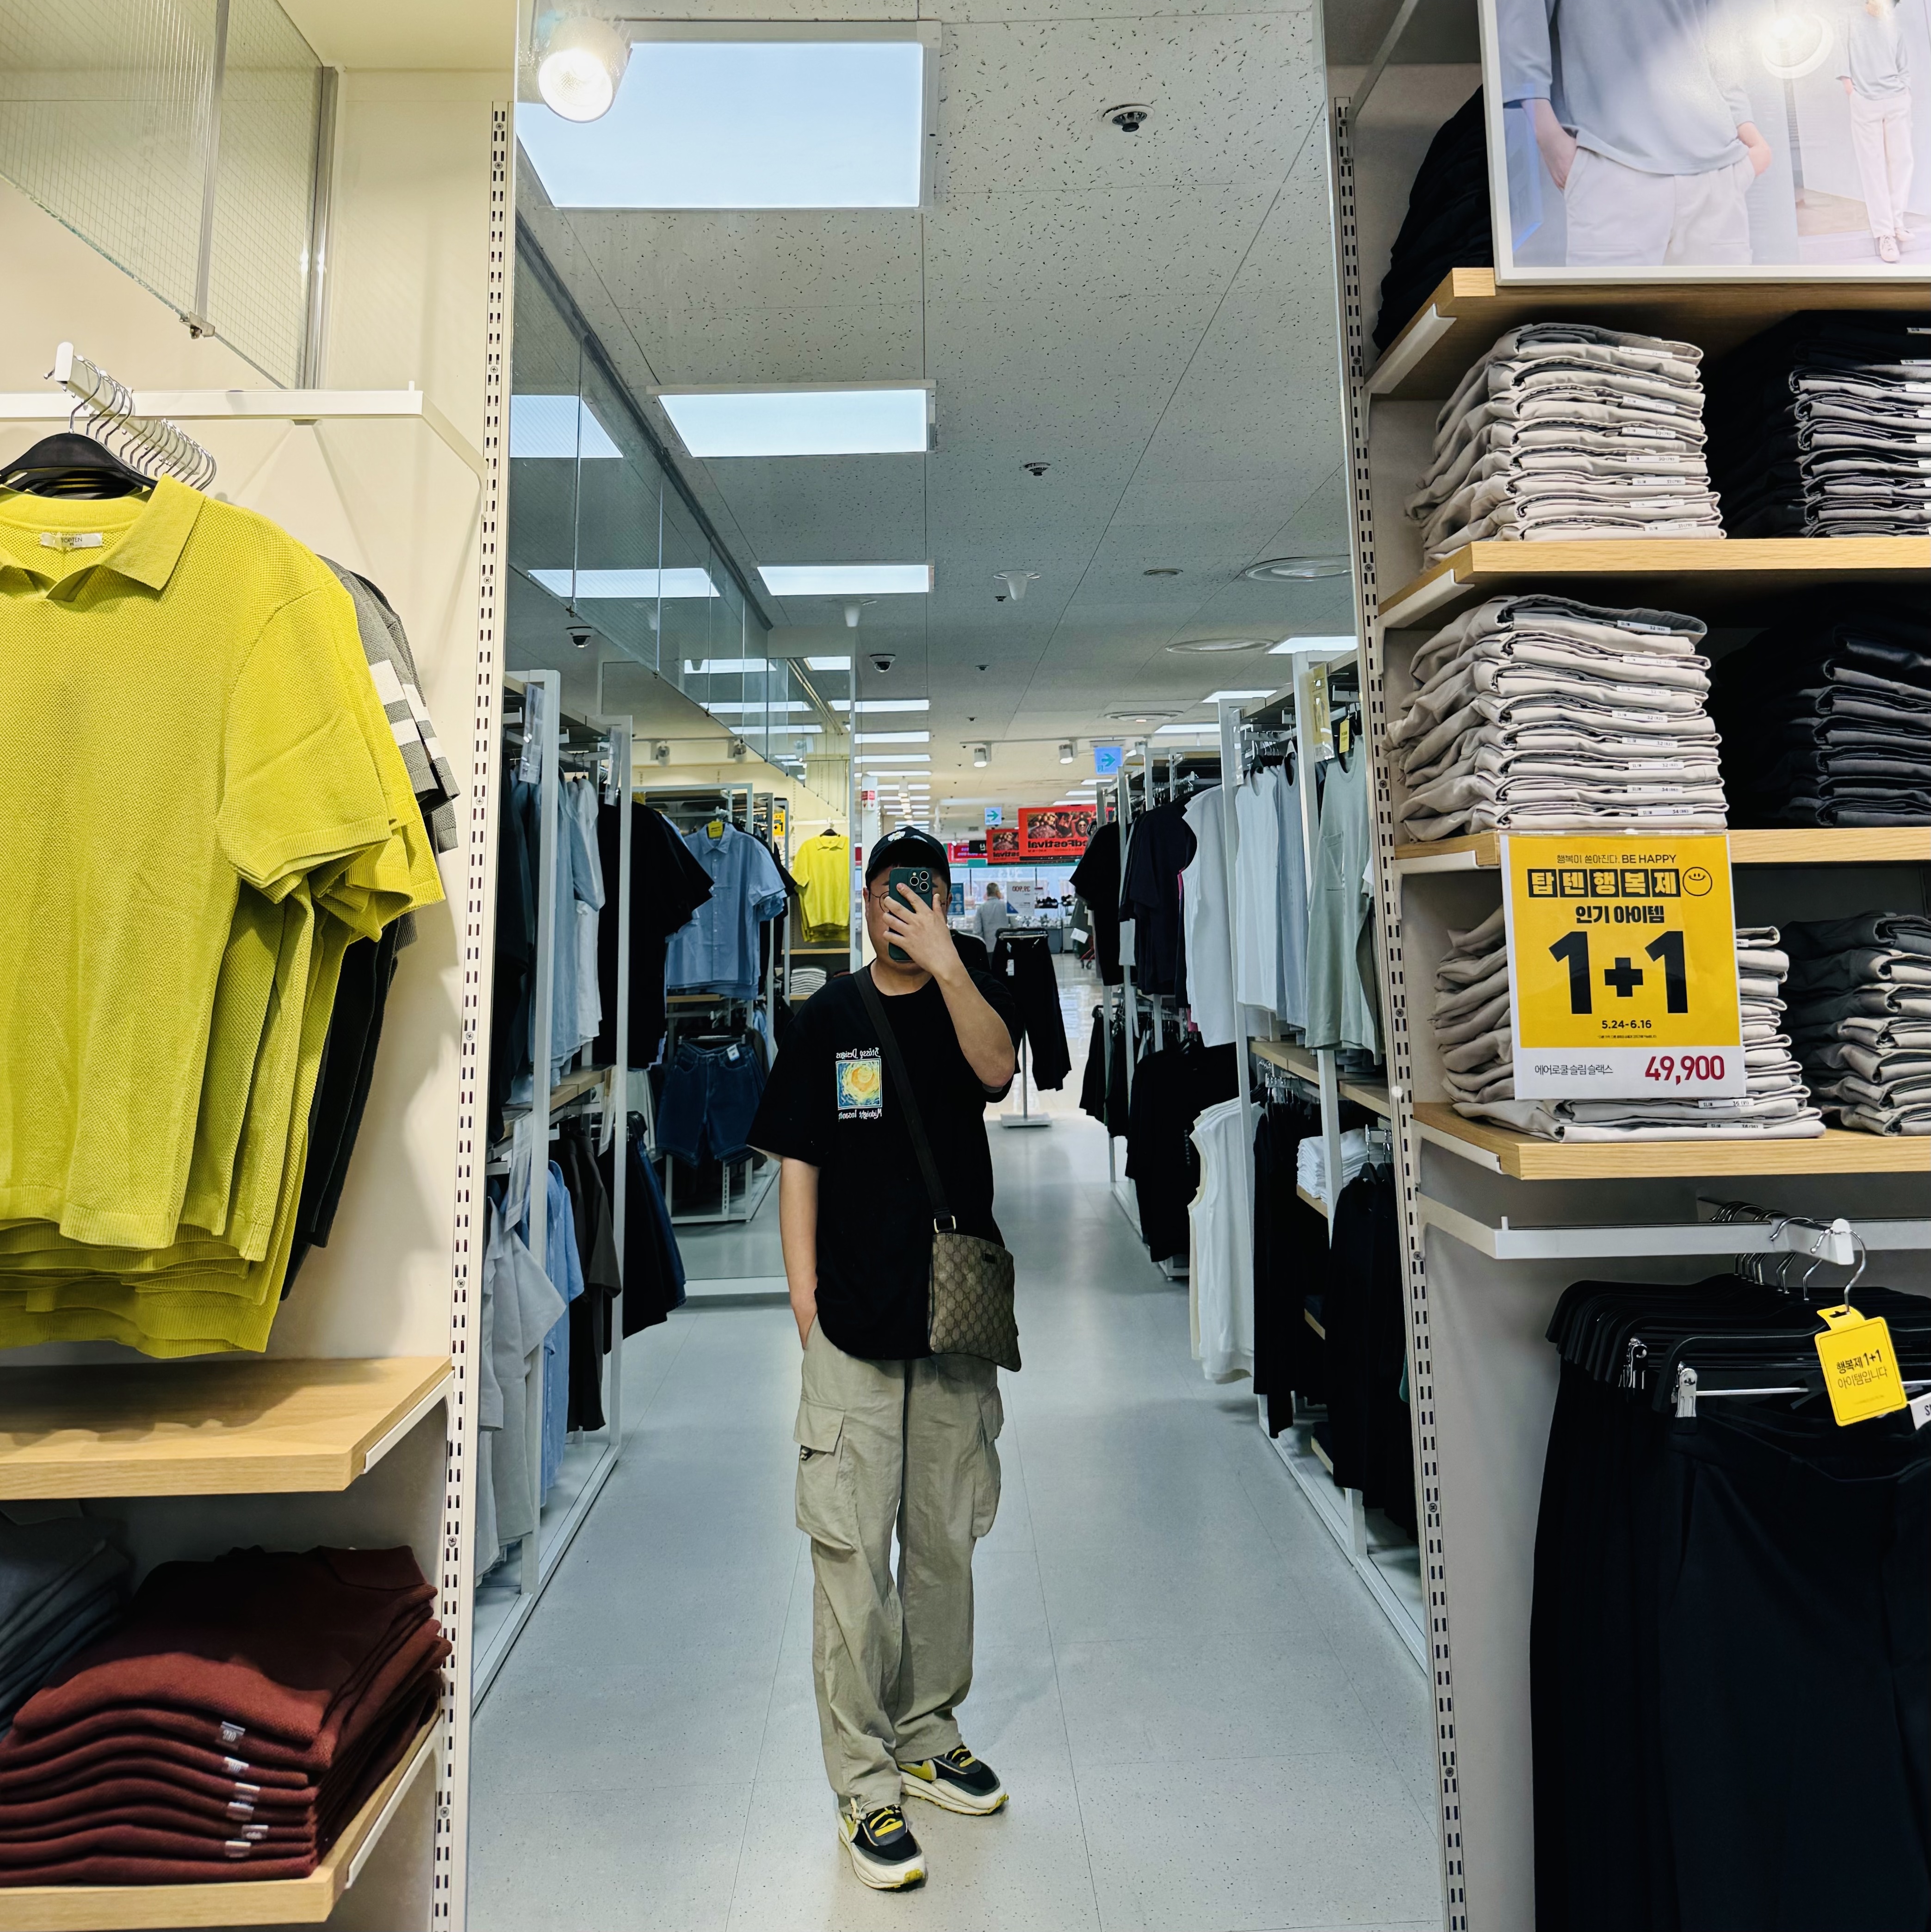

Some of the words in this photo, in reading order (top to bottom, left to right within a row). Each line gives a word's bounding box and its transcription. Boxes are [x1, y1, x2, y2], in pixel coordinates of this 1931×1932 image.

[1557, 855, 1582, 864] 행복이
[1622, 855, 1636, 864] BE
[1639, 854, 1677, 864] HAPPY
[1529, 870, 1679, 896] 탑텐행복제
[1576, 905, 1609, 924] 인기
[1614, 905, 1665, 924] 아이템
[1548, 930, 1688, 1015] 1+1
[1601, 1020, 1652, 1029] 5.24-6.16
[1645, 1055, 1725, 1085] 49,900
[1836, 1356, 1863, 1374] 행복제
[1863, 1349, 1882, 1366] 1+1
